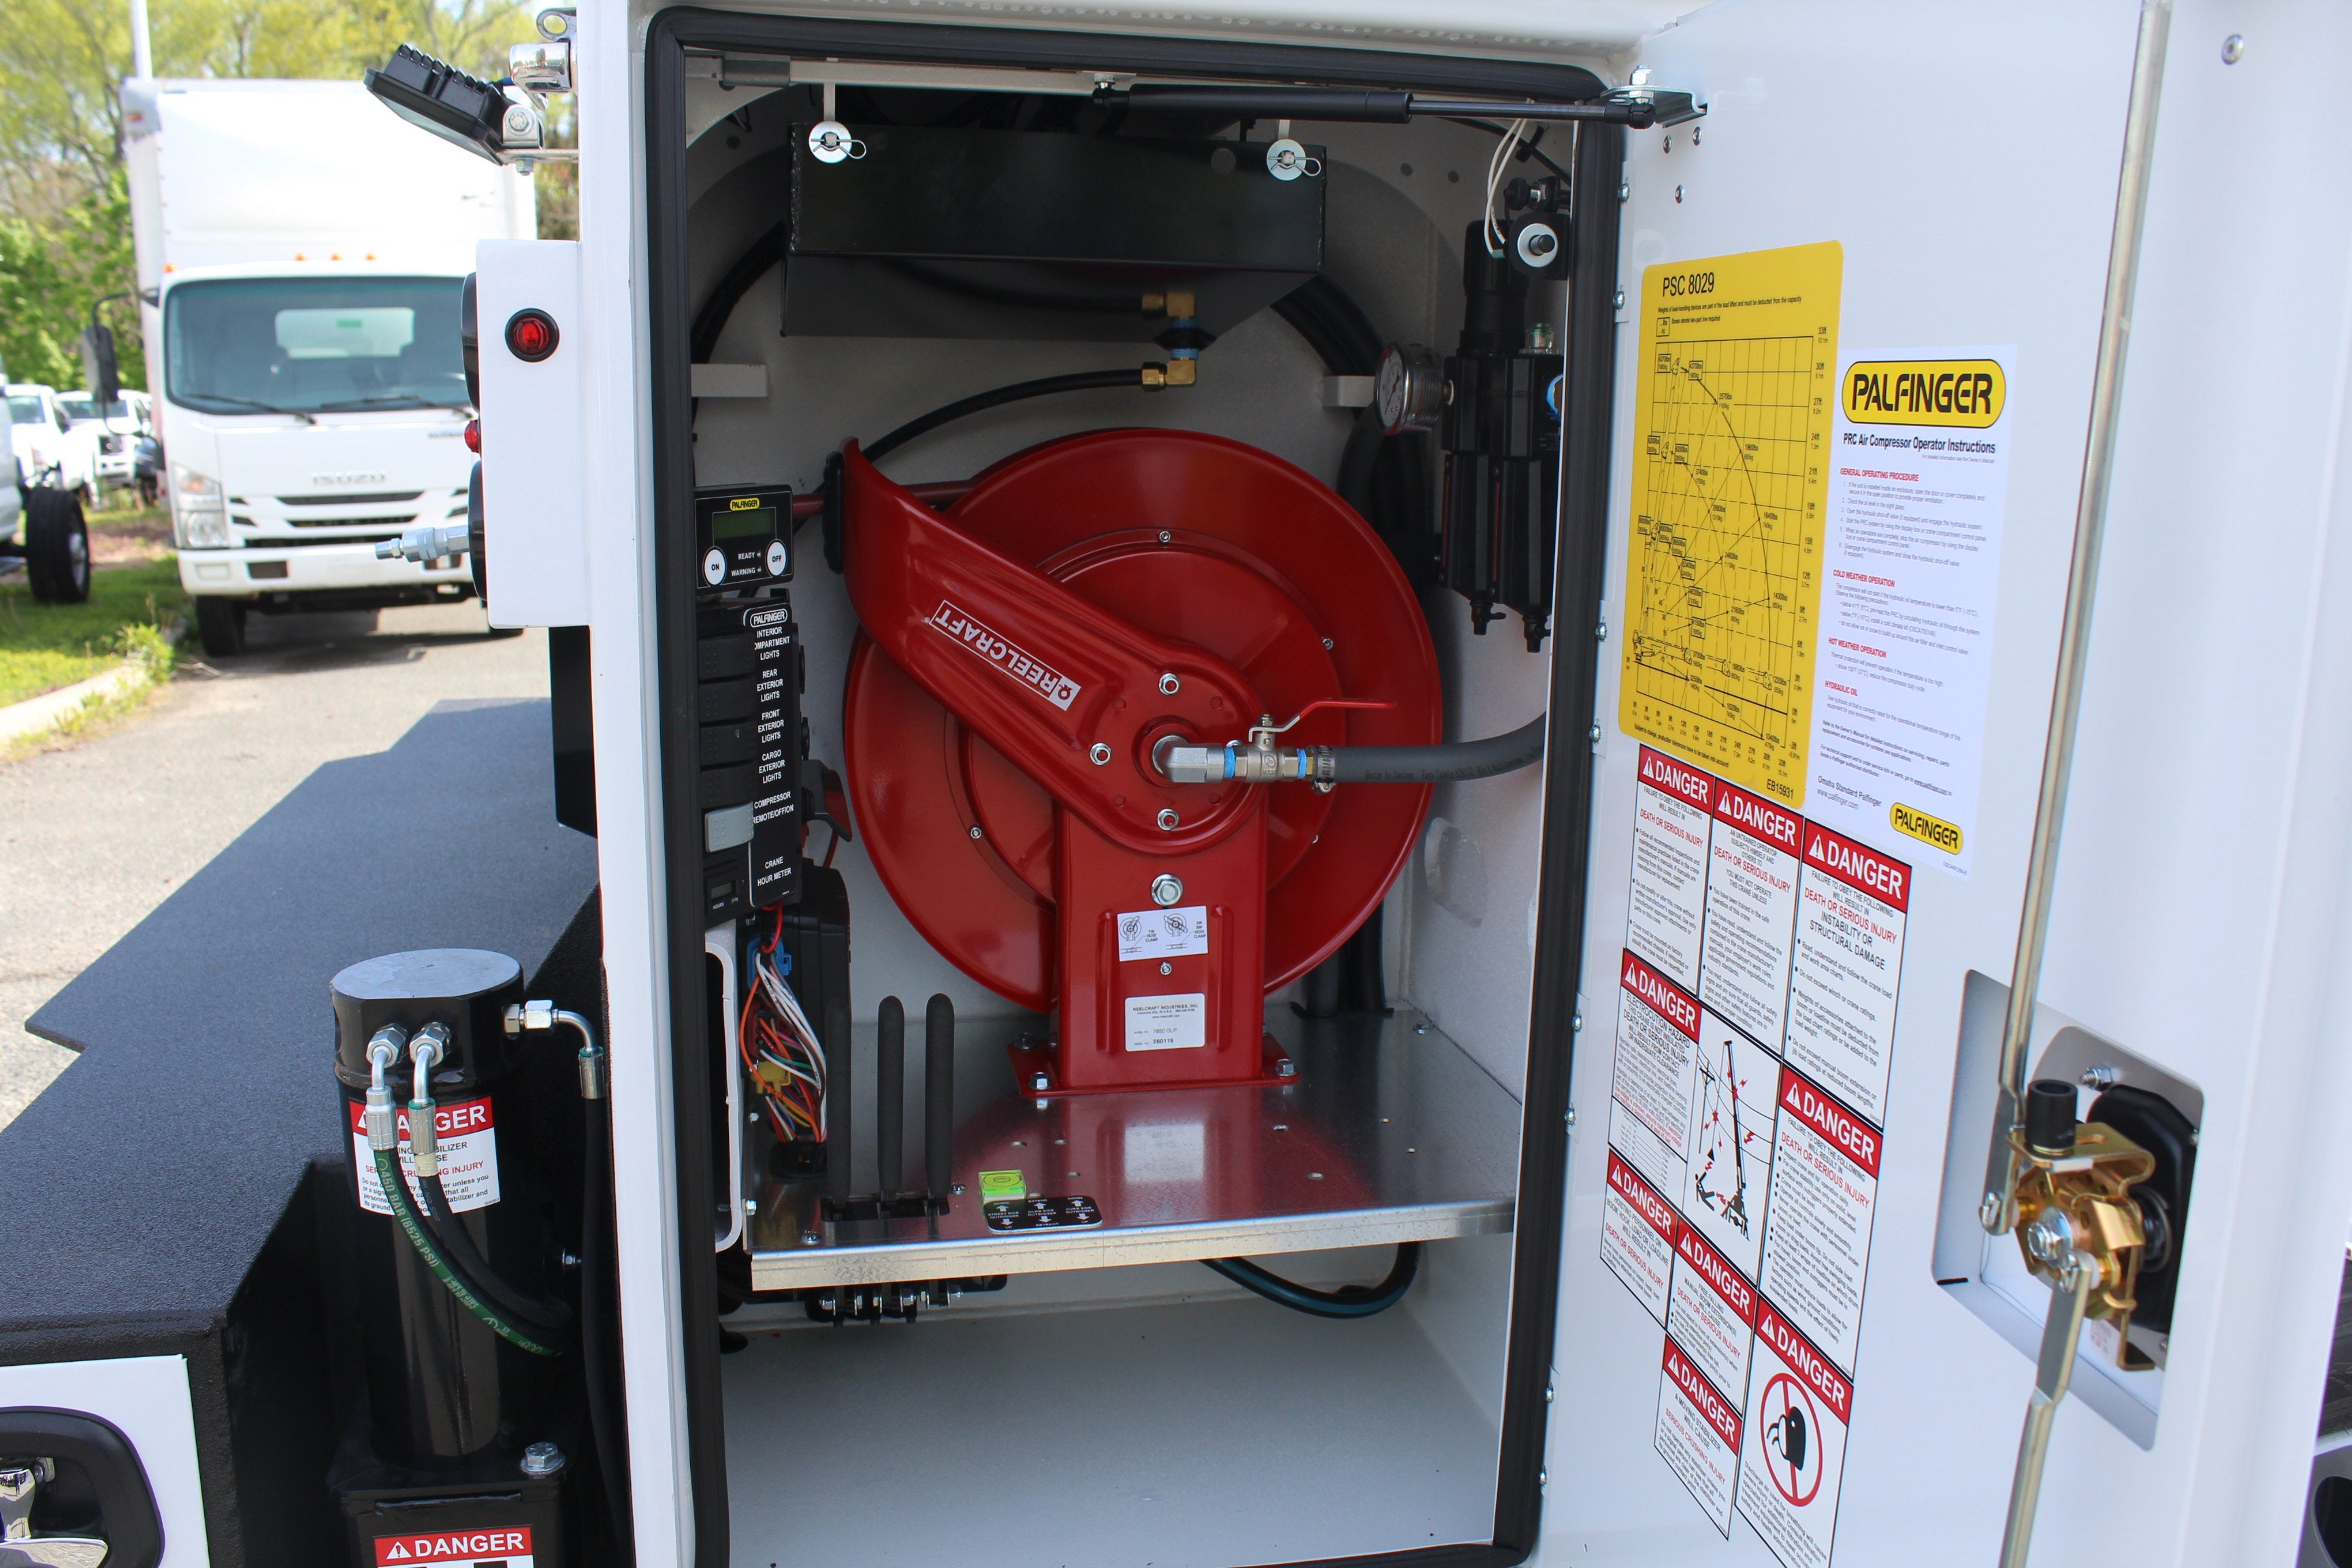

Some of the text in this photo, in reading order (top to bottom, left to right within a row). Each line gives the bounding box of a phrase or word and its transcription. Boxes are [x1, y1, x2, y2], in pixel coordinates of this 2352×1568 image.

[1663, 272, 1714, 297] PSC 8029
[1852, 373, 1993, 414] PALFINGER
[1844, 433, 1995, 453] PRC Air Compressor Operator Instructions
[1840, 468, 1919, 482] GENERAL OPERATING PROCEDURE
[732, 500, 757, 508] PALFINGER
[731, 568, 755, 576] WARNING
[1833, 570, 1895, 587] COLD WEATHER OPERATION
[753, 611, 785, 624] PALFINGER
[755, 637, 789, 650] MPARTMENT
[757, 627, 782, 638] INTERIOR
[760, 650, 779, 660] LIGHTS
[935, 610, 1058, 693] REELCRAFT
[1829, 637, 1886, 658] HOT WEATHER OPERATION
[757, 679, 783, 691] EXTERIOR
[762, 669, 777, 679] REAR
[761, 691, 779, 702] LIGHTS
[1825, 681, 1858, 696] HYDRAULIC OIL
[758, 719, 784, 732] EXTERIOR
[762, 709, 779, 720] FRONT
[762, 732, 781, 743] LIGHTS
[759, 760, 785, 774] EXTERIOR
[762, 749, 781, 761] CARGO
[763, 772, 781, 783] LIGHTS
[1655, 760, 1708, 804] DANGER
[1767, 779, 1794, 800] EB15931
[754, 791, 791, 809] COMPRESSOR
[1817, 788, 1859, 810] www.palfinger.com
[1818, 775, 1881, 807] Omaha Standard Palfinger
[1640, 808, 1703, 848] DEATH OR SERIOUS INJURY
[1733, 796, 1796, 847] DANGER
[1895, 808, 1958, 849] PALFINGER
[765, 856, 783, 869] CRANE
[1714, 845, 1791, 893] DEATH OR SERIOUS INJURY
[1827, 840, 1902, 900] DANGER
[757, 868, 791, 886] HOUR METER
[1812, 870, 1893, 917] FAILURE TO OBEY THE FOLLOWING
[1832, 891, 1844, 902] WILL
[1844, 897, 1863, 912] RESULT
[1805, 887, 1897, 944] DEATH OR SERIOUS INJURY
[1820, 911, 1872, 947] INSTABILITY OR
[1810, 920, 1885, 970] STRUCTURAL DAMAGE
[1638, 969, 1695, 1032] DANGER
[1627, 993, 1690, 1048] ELECTROCUTION HAZARD
[1624, 1009, 1689, 1067] DEATH OR SERIOUS INJURY
[1803, 1092, 1875, 1166] DANGER
[1788, 1117, 1865, 1182] FAILURE TO OBEY THE FOLLOWING
[452, 1161, 484, 1173] INJURY
[1782, 1132, 1869, 1209] DEATH OR SERIOUS INJURY
[453, 1175, 489, 1187] unless you
[364, 1194, 389, 1203] personne
[371, 1203, 391, 1211] ground
[1623, 1171, 1671, 1236] DANGER
[380, 1171, 440, 1267] 450 BAR (6525 PSI)
[1605, 1222, 1664, 1289] DEATH OR SERIOUS INJURY
[1694, 1241, 1750, 1316] DANGER
[1678, 1287, 1741, 1359] DEATH OR SERIOUS INJURY
[1777, 1325, 1846, 1411] DANGER
[1681, 1366, 1735, 1443] DANGER
[1679, 1398, 1695, 1421] MOVING
[1696, 1418, 1721, 1452] STABILIZER
[1684, 1414, 1710, 1450] WILL CAUSE
[1666, 1407, 1726, 1485] SERIOUS CRUSHING INJURY
[414, 1533, 524, 1557] DANGER
